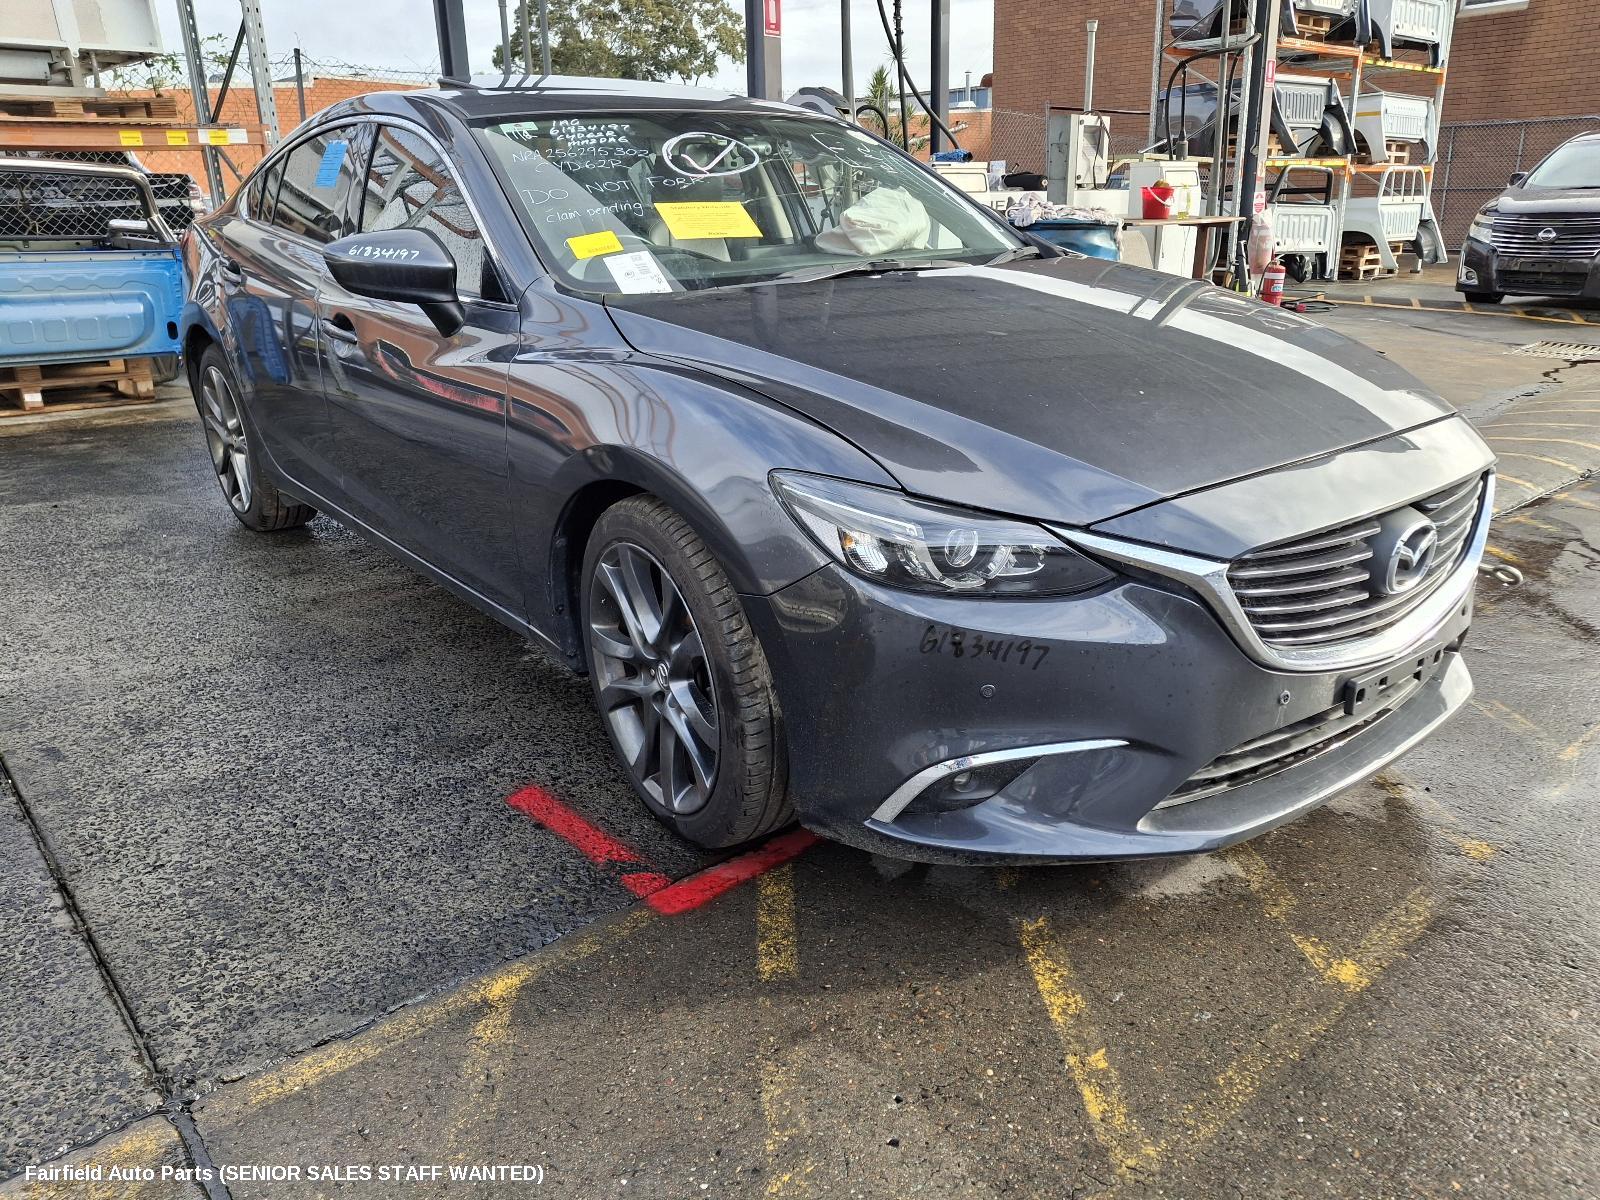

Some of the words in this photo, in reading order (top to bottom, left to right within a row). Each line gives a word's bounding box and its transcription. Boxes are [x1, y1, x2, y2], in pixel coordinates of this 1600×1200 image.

[549, 123, 630, 136] 61834197
[522, 188, 569, 205] DO
[585, 180, 630, 194] NOT
[586, 200, 644, 218] pending
[348, 245, 420, 261] 61834197
[918, 624, 1049, 670] 61834197
